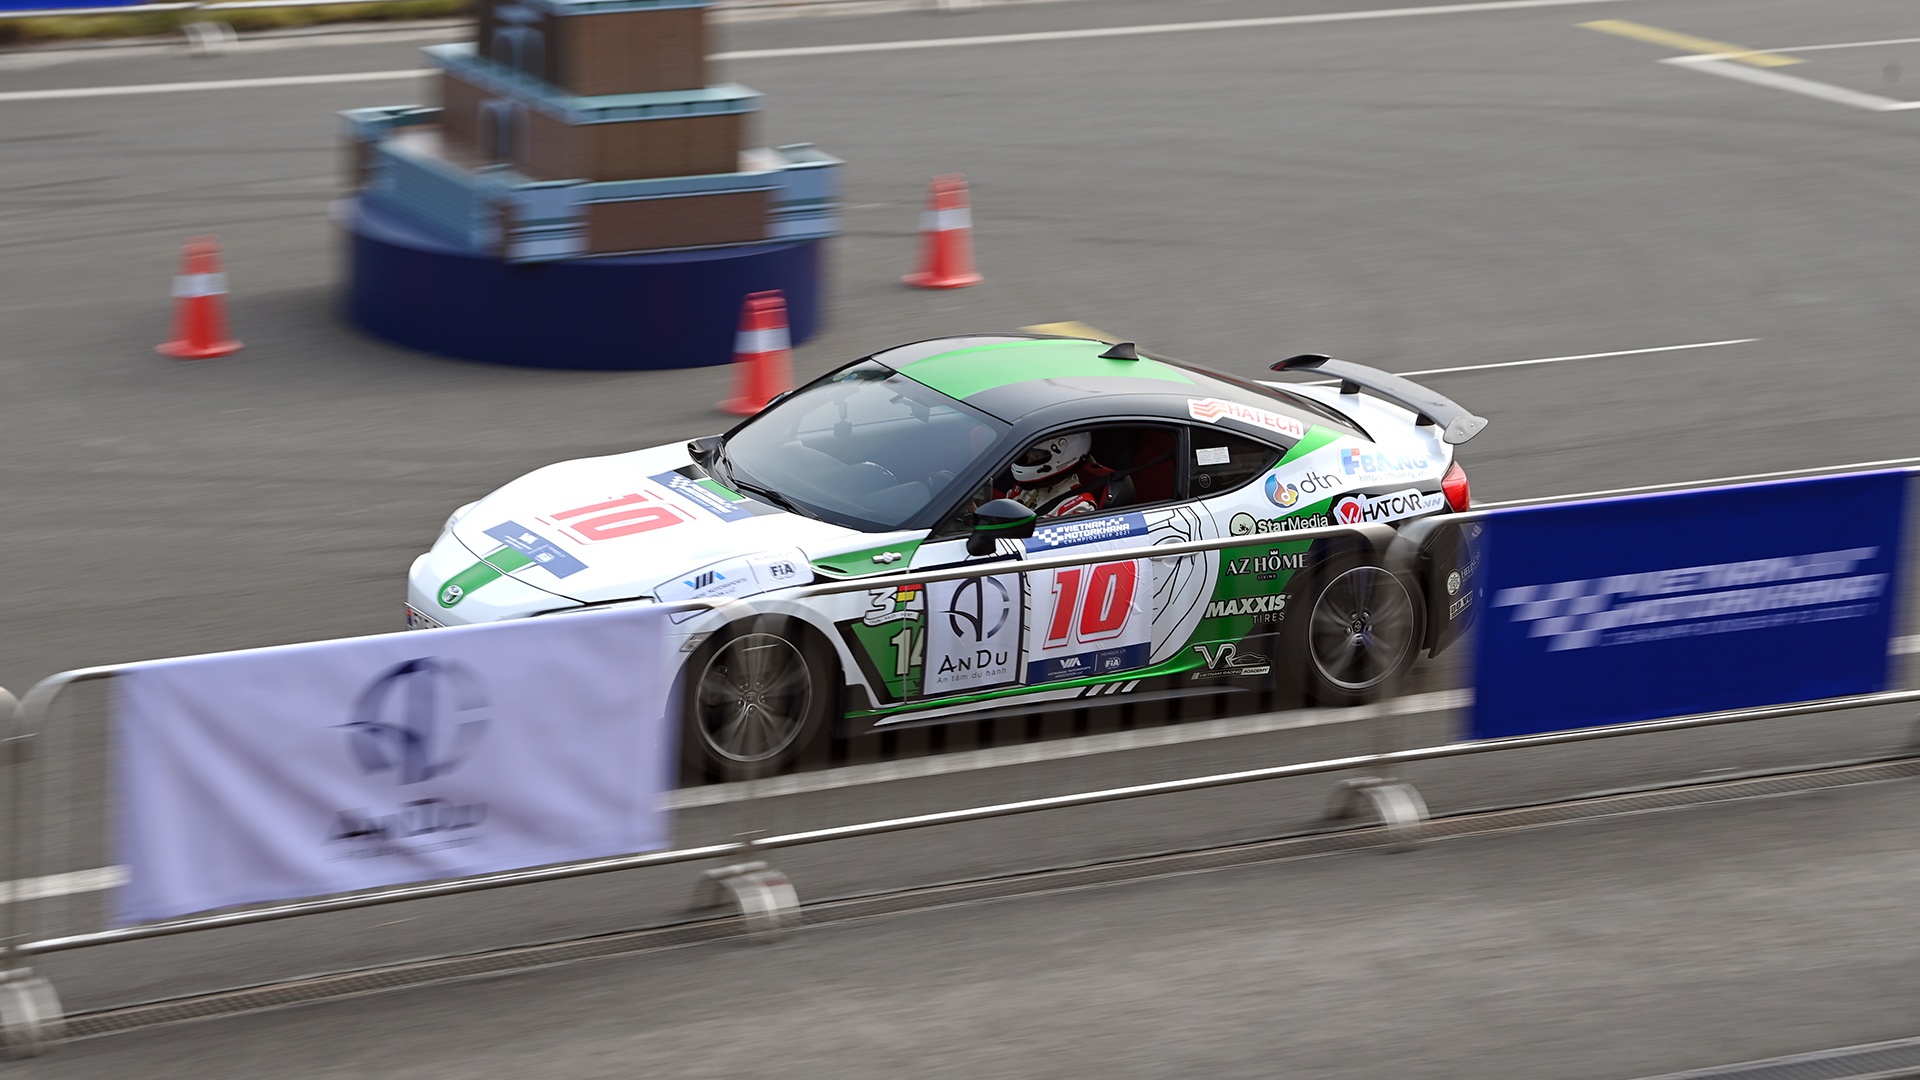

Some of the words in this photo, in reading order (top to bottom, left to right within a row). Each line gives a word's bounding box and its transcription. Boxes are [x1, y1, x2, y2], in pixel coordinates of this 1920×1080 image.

[1228, 404, 1301, 435] HATECH
[1300, 471, 1343, 494] dtn
[549, 492, 686, 542] 10
[1063, 519, 1106, 533] VIETNAM
[1064, 523, 1130, 540] MOTORKHANA
[1226, 558, 1250, 576] AZ
[1043, 560, 1139, 648] 10
[1204, 594, 1287, 619] MAXXIS
[1252, 611, 1285, 624] TIRES
